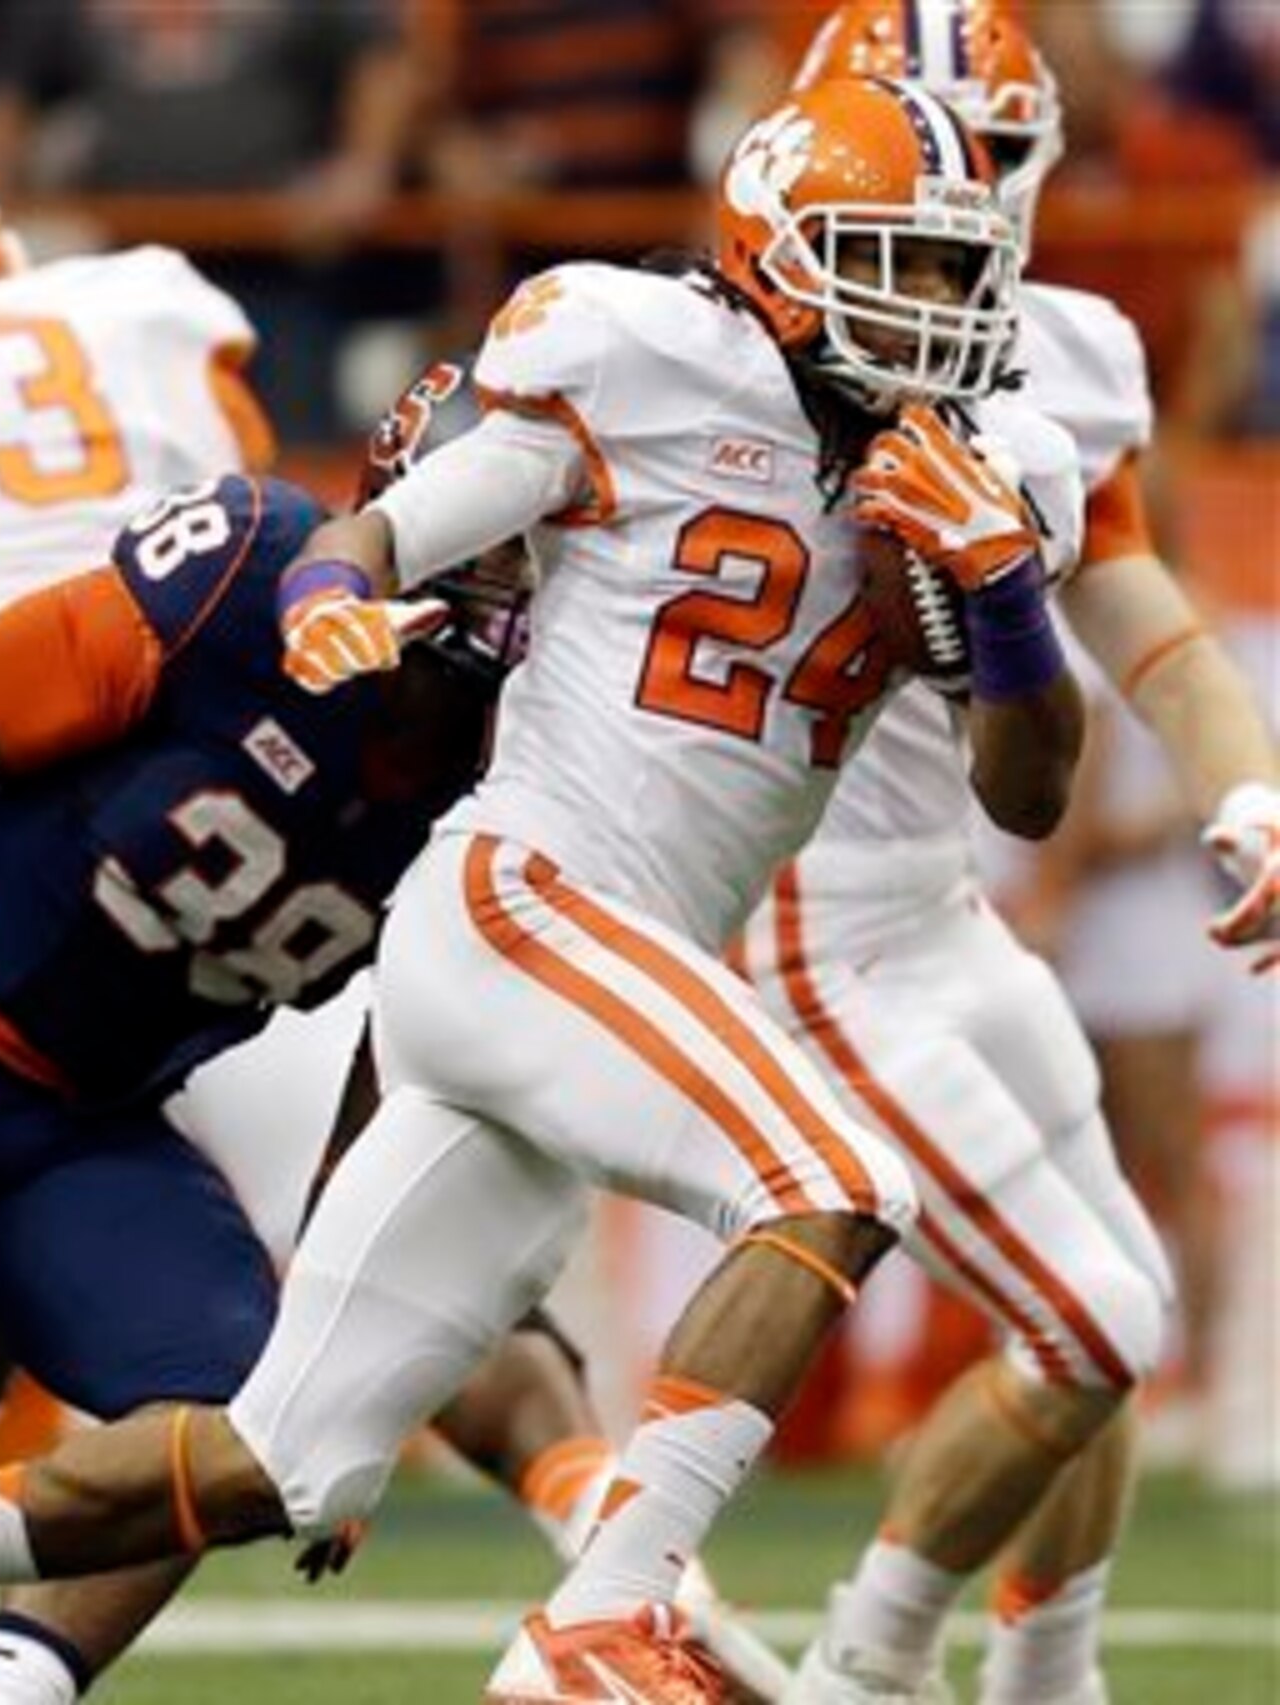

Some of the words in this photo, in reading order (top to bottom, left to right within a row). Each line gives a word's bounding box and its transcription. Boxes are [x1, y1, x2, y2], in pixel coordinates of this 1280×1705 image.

[713, 443, 769, 473] ACC
[634, 504, 885, 769] 24
[254, 735, 306, 783] ACC
[94, 793, 376, 1006] 38
